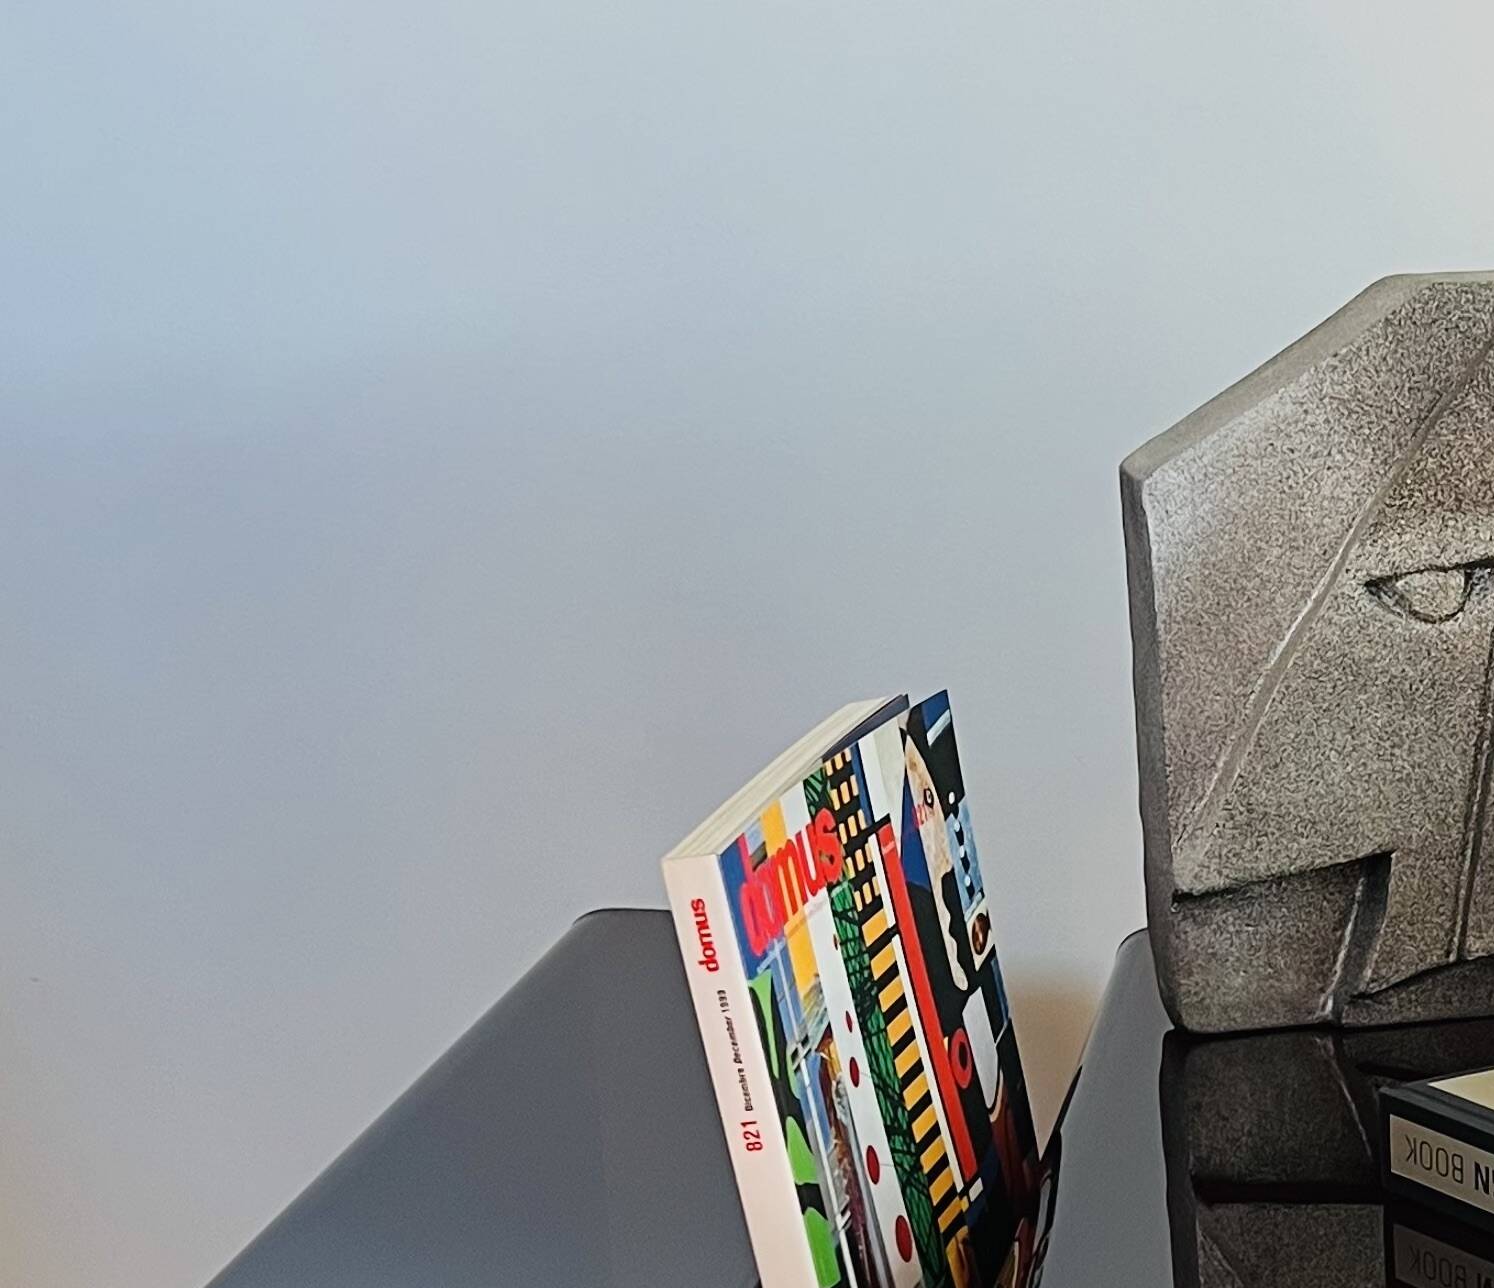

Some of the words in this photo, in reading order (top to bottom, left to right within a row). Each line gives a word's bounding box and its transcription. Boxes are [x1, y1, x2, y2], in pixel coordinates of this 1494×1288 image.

[739, 807, 844, 957] domus
[691, 898, 719, 972] domus
[740, 1120, 763, 1152] 821
[1404, 1133, 1464, 1185] BOOK
